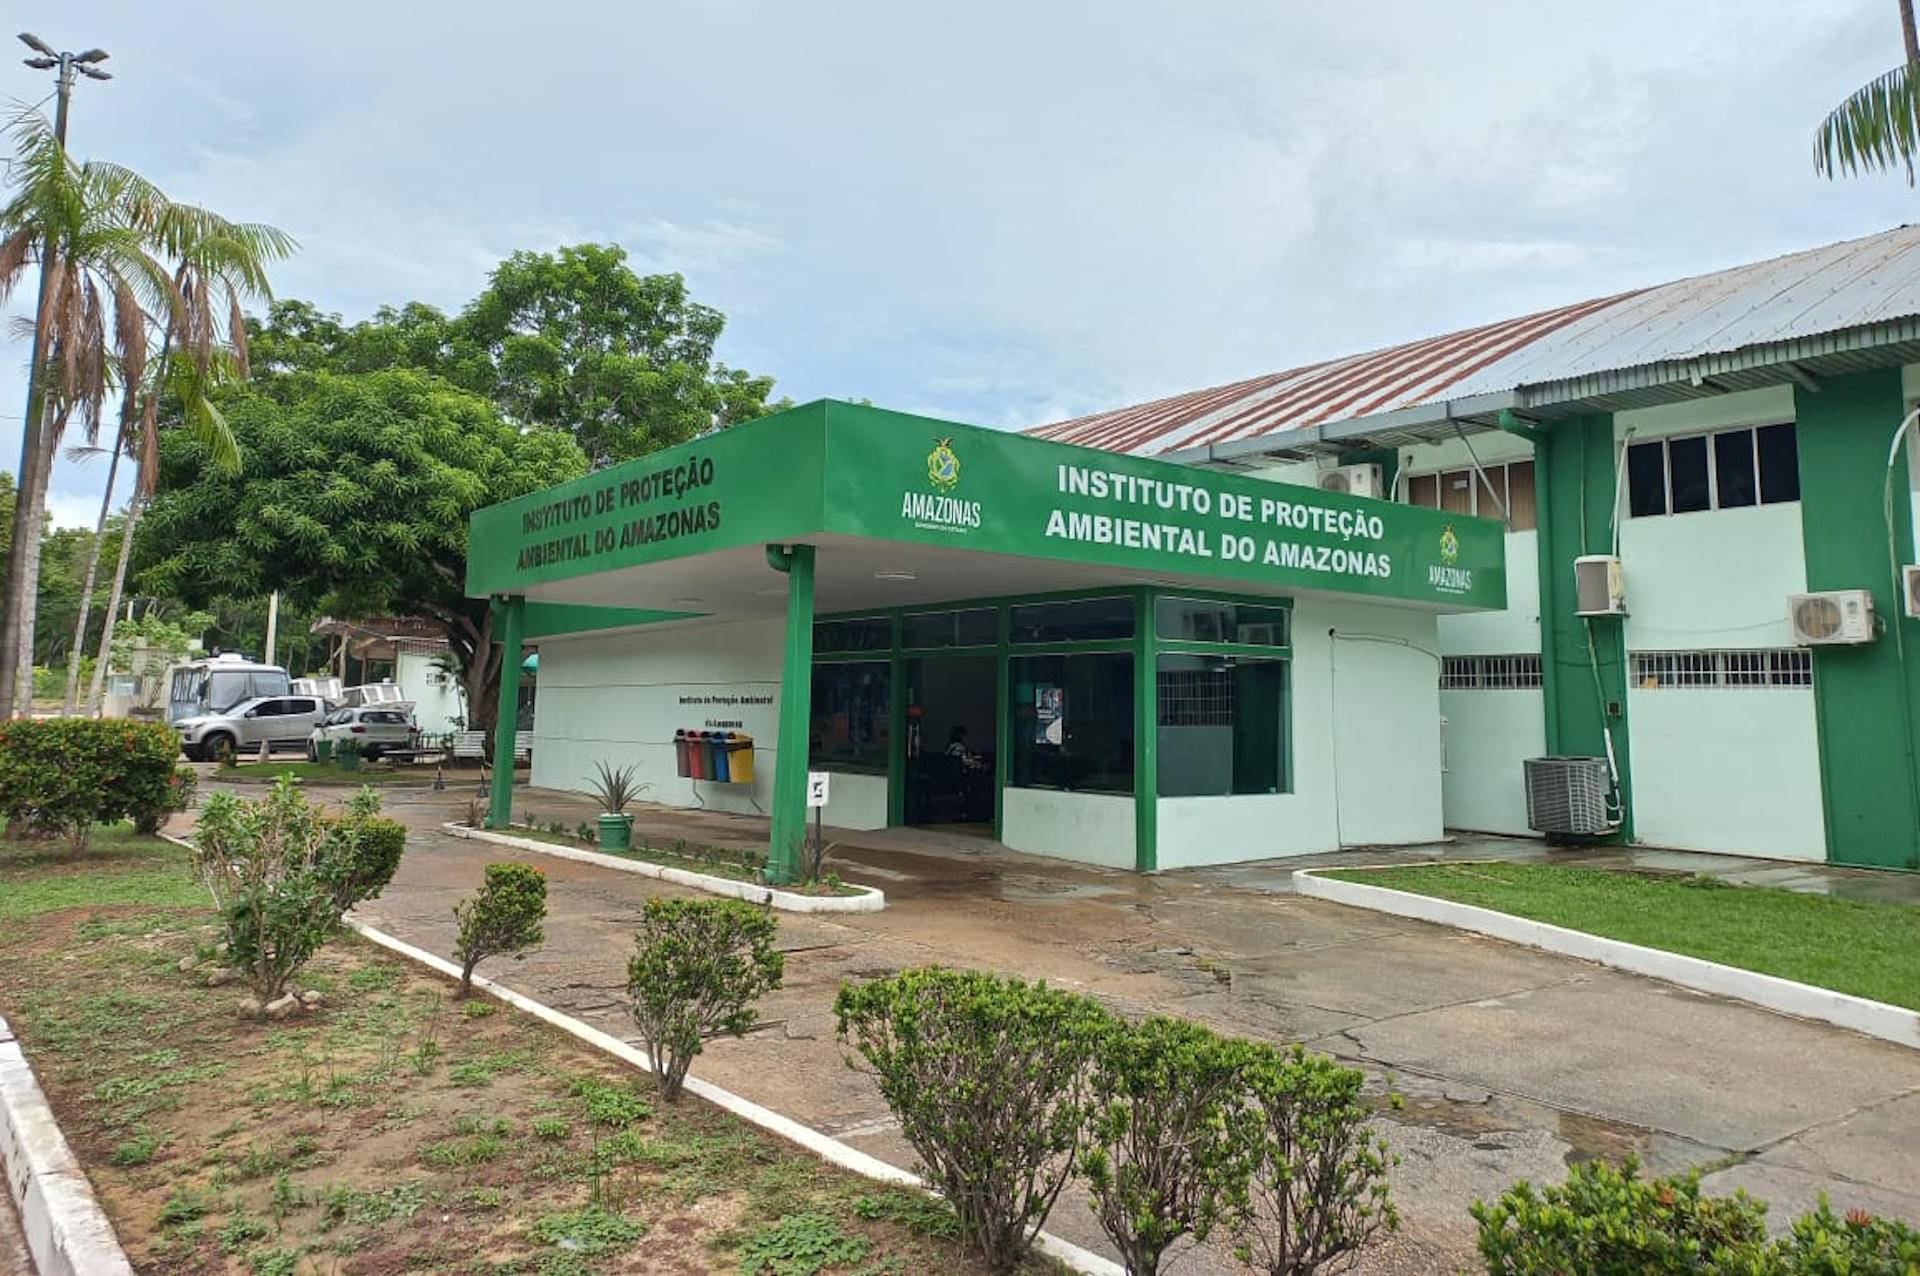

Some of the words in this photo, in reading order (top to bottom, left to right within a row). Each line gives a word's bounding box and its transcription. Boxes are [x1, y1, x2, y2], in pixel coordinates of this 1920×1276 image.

[522, 494, 591, 535] INSTITUTO
[595, 487, 615, 514] DE
[620, 456, 714, 508] PROTEÇÃO
[901, 491, 981, 528] AMAZONAS
[1058, 464, 1211, 514] INSTITUTO
[1219, 493, 1253, 521] DE
[1260, 498, 1384, 541] PROTEÇÃO
[516, 533, 591, 570] AMBIENTAL
[594, 527, 615, 554] DO
[619, 501, 720, 549] AMAZONAS
[1045, 509, 1212, 557] AMBIENTAL
[1221, 534, 1256, 562] DO
[1262, 540, 1391, 578] AMAZONAS
